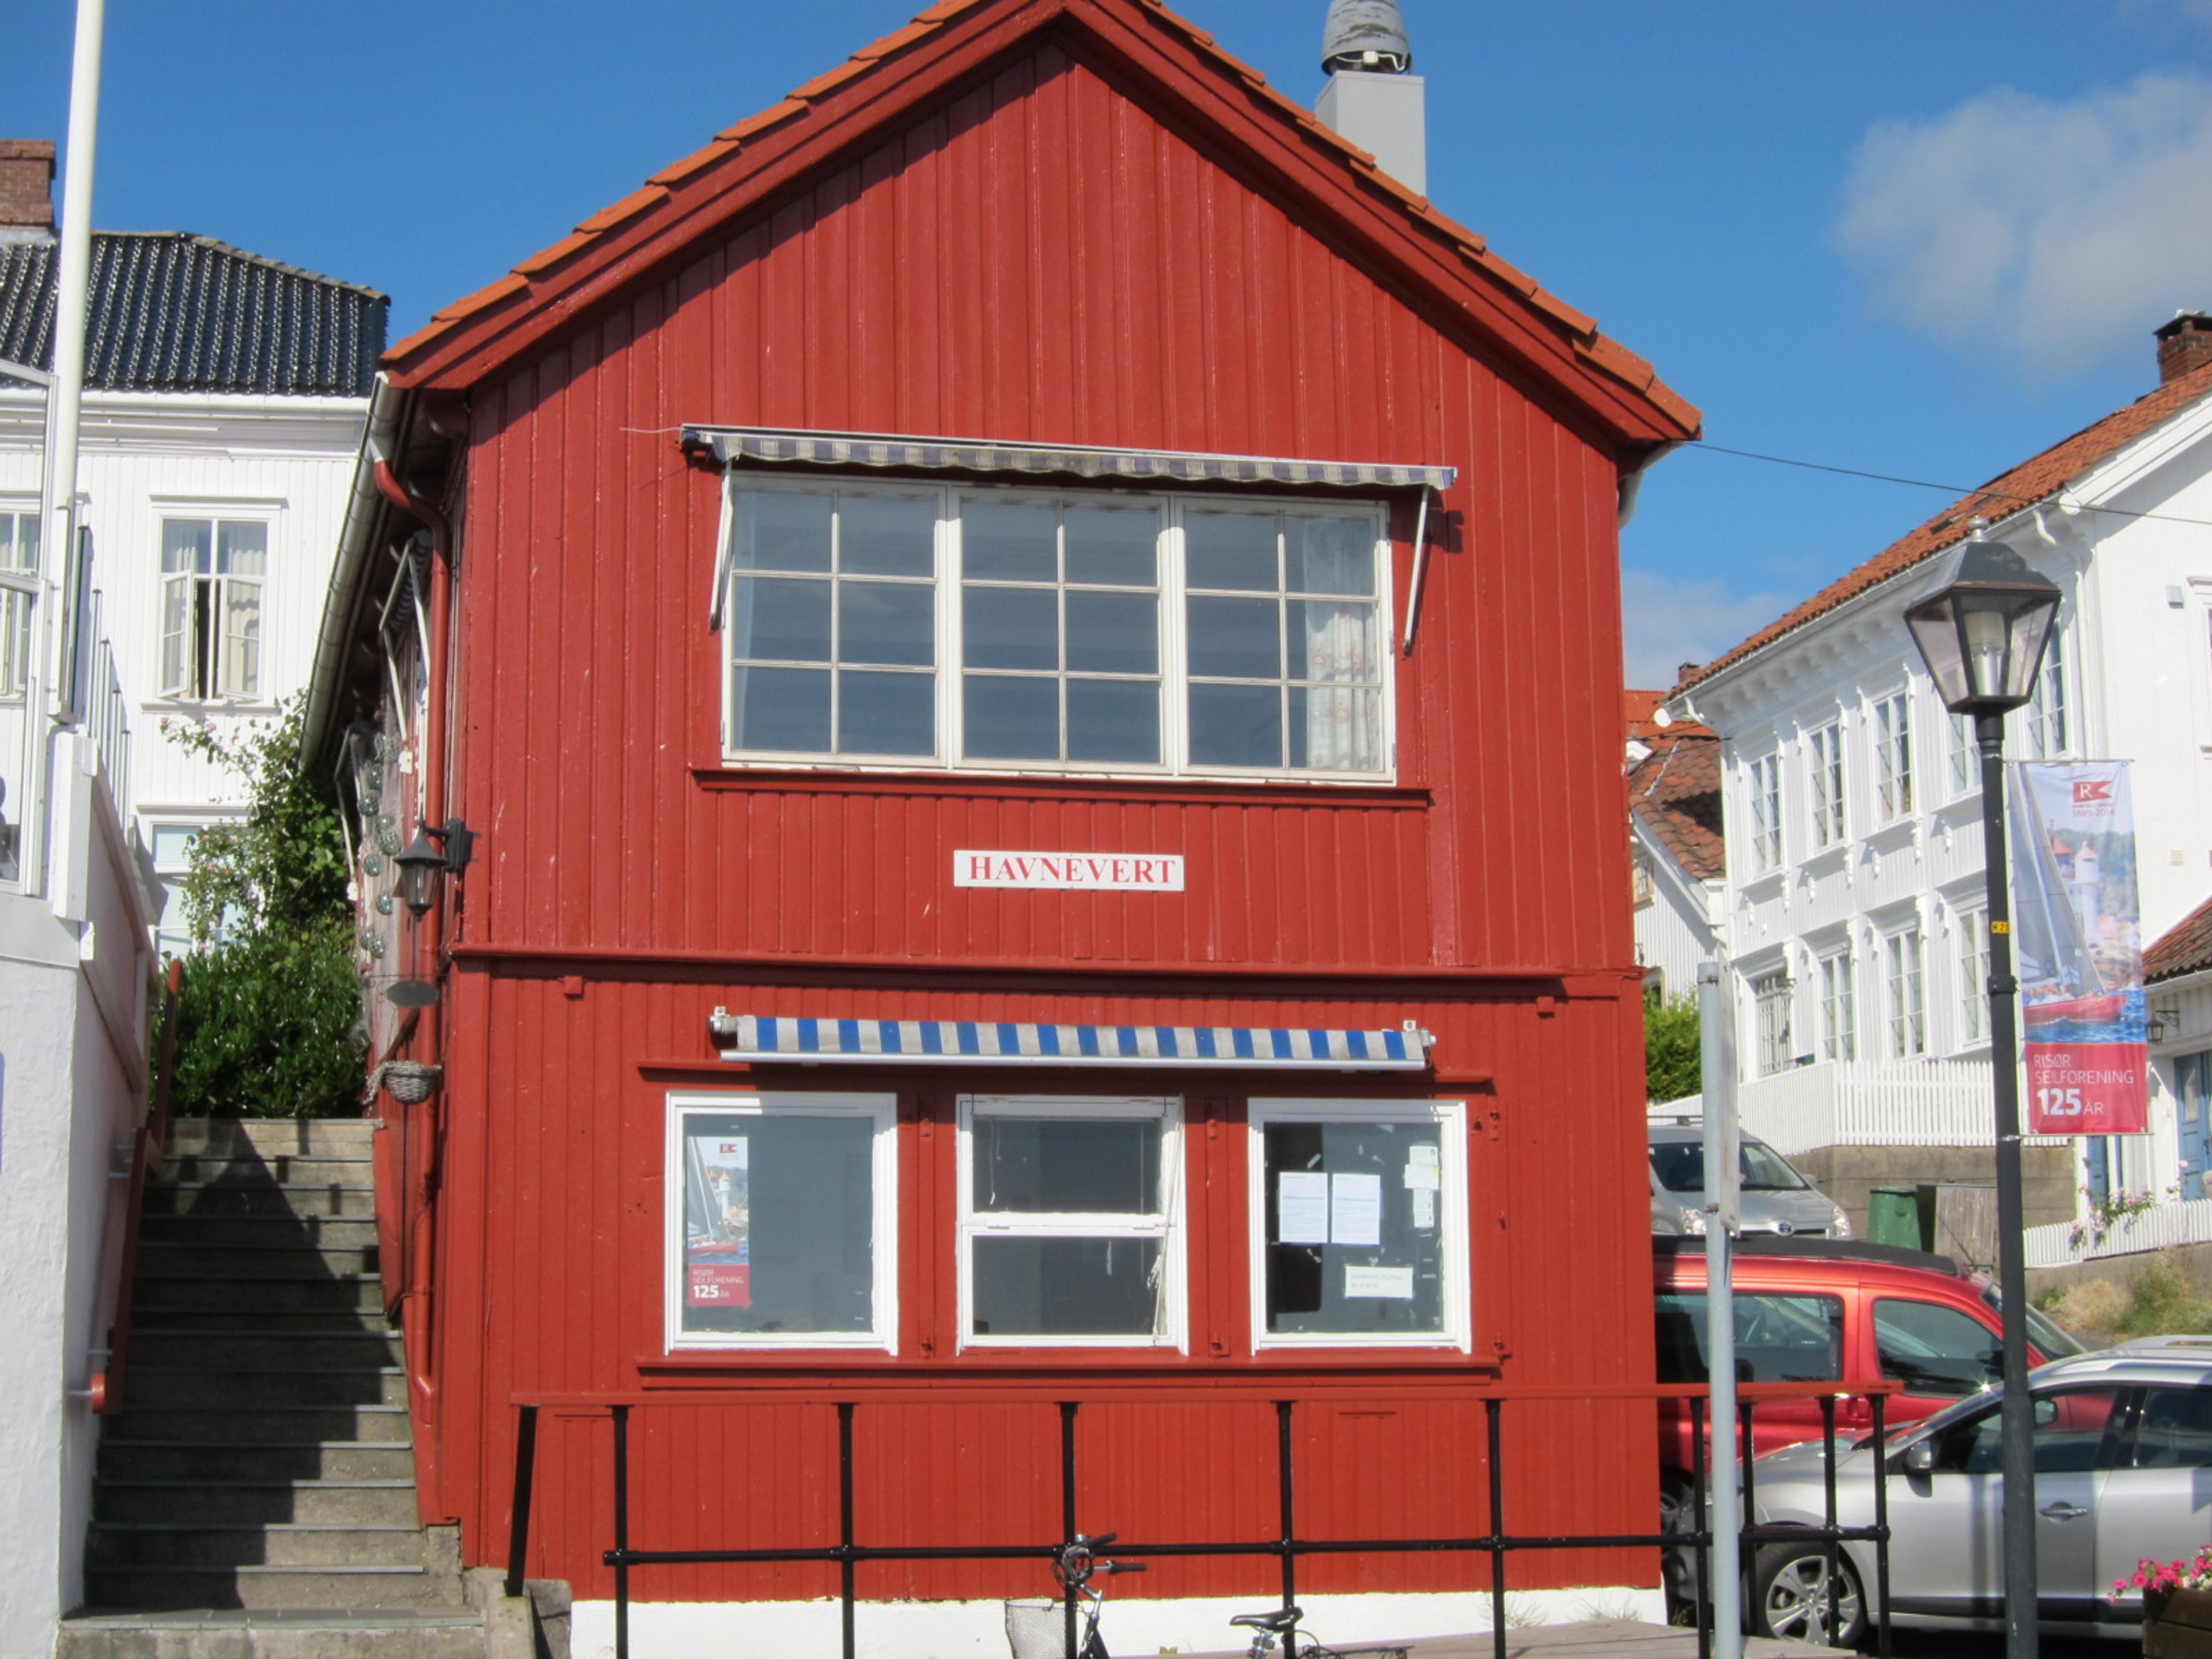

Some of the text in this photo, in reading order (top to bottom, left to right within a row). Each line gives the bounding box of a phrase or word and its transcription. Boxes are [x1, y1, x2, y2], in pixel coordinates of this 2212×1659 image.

[2080, 783, 2093, 798] R
[969, 856, 1176, 883] HAVNEVERT
[2034, 1054, 2071, 1068] RISØR
[2035, 1070, 2134, 1084] SEILFORENING
[2037, 1088, 2104, 1115] 125 ÅR
[693, 1285, 719, 1298] 125
